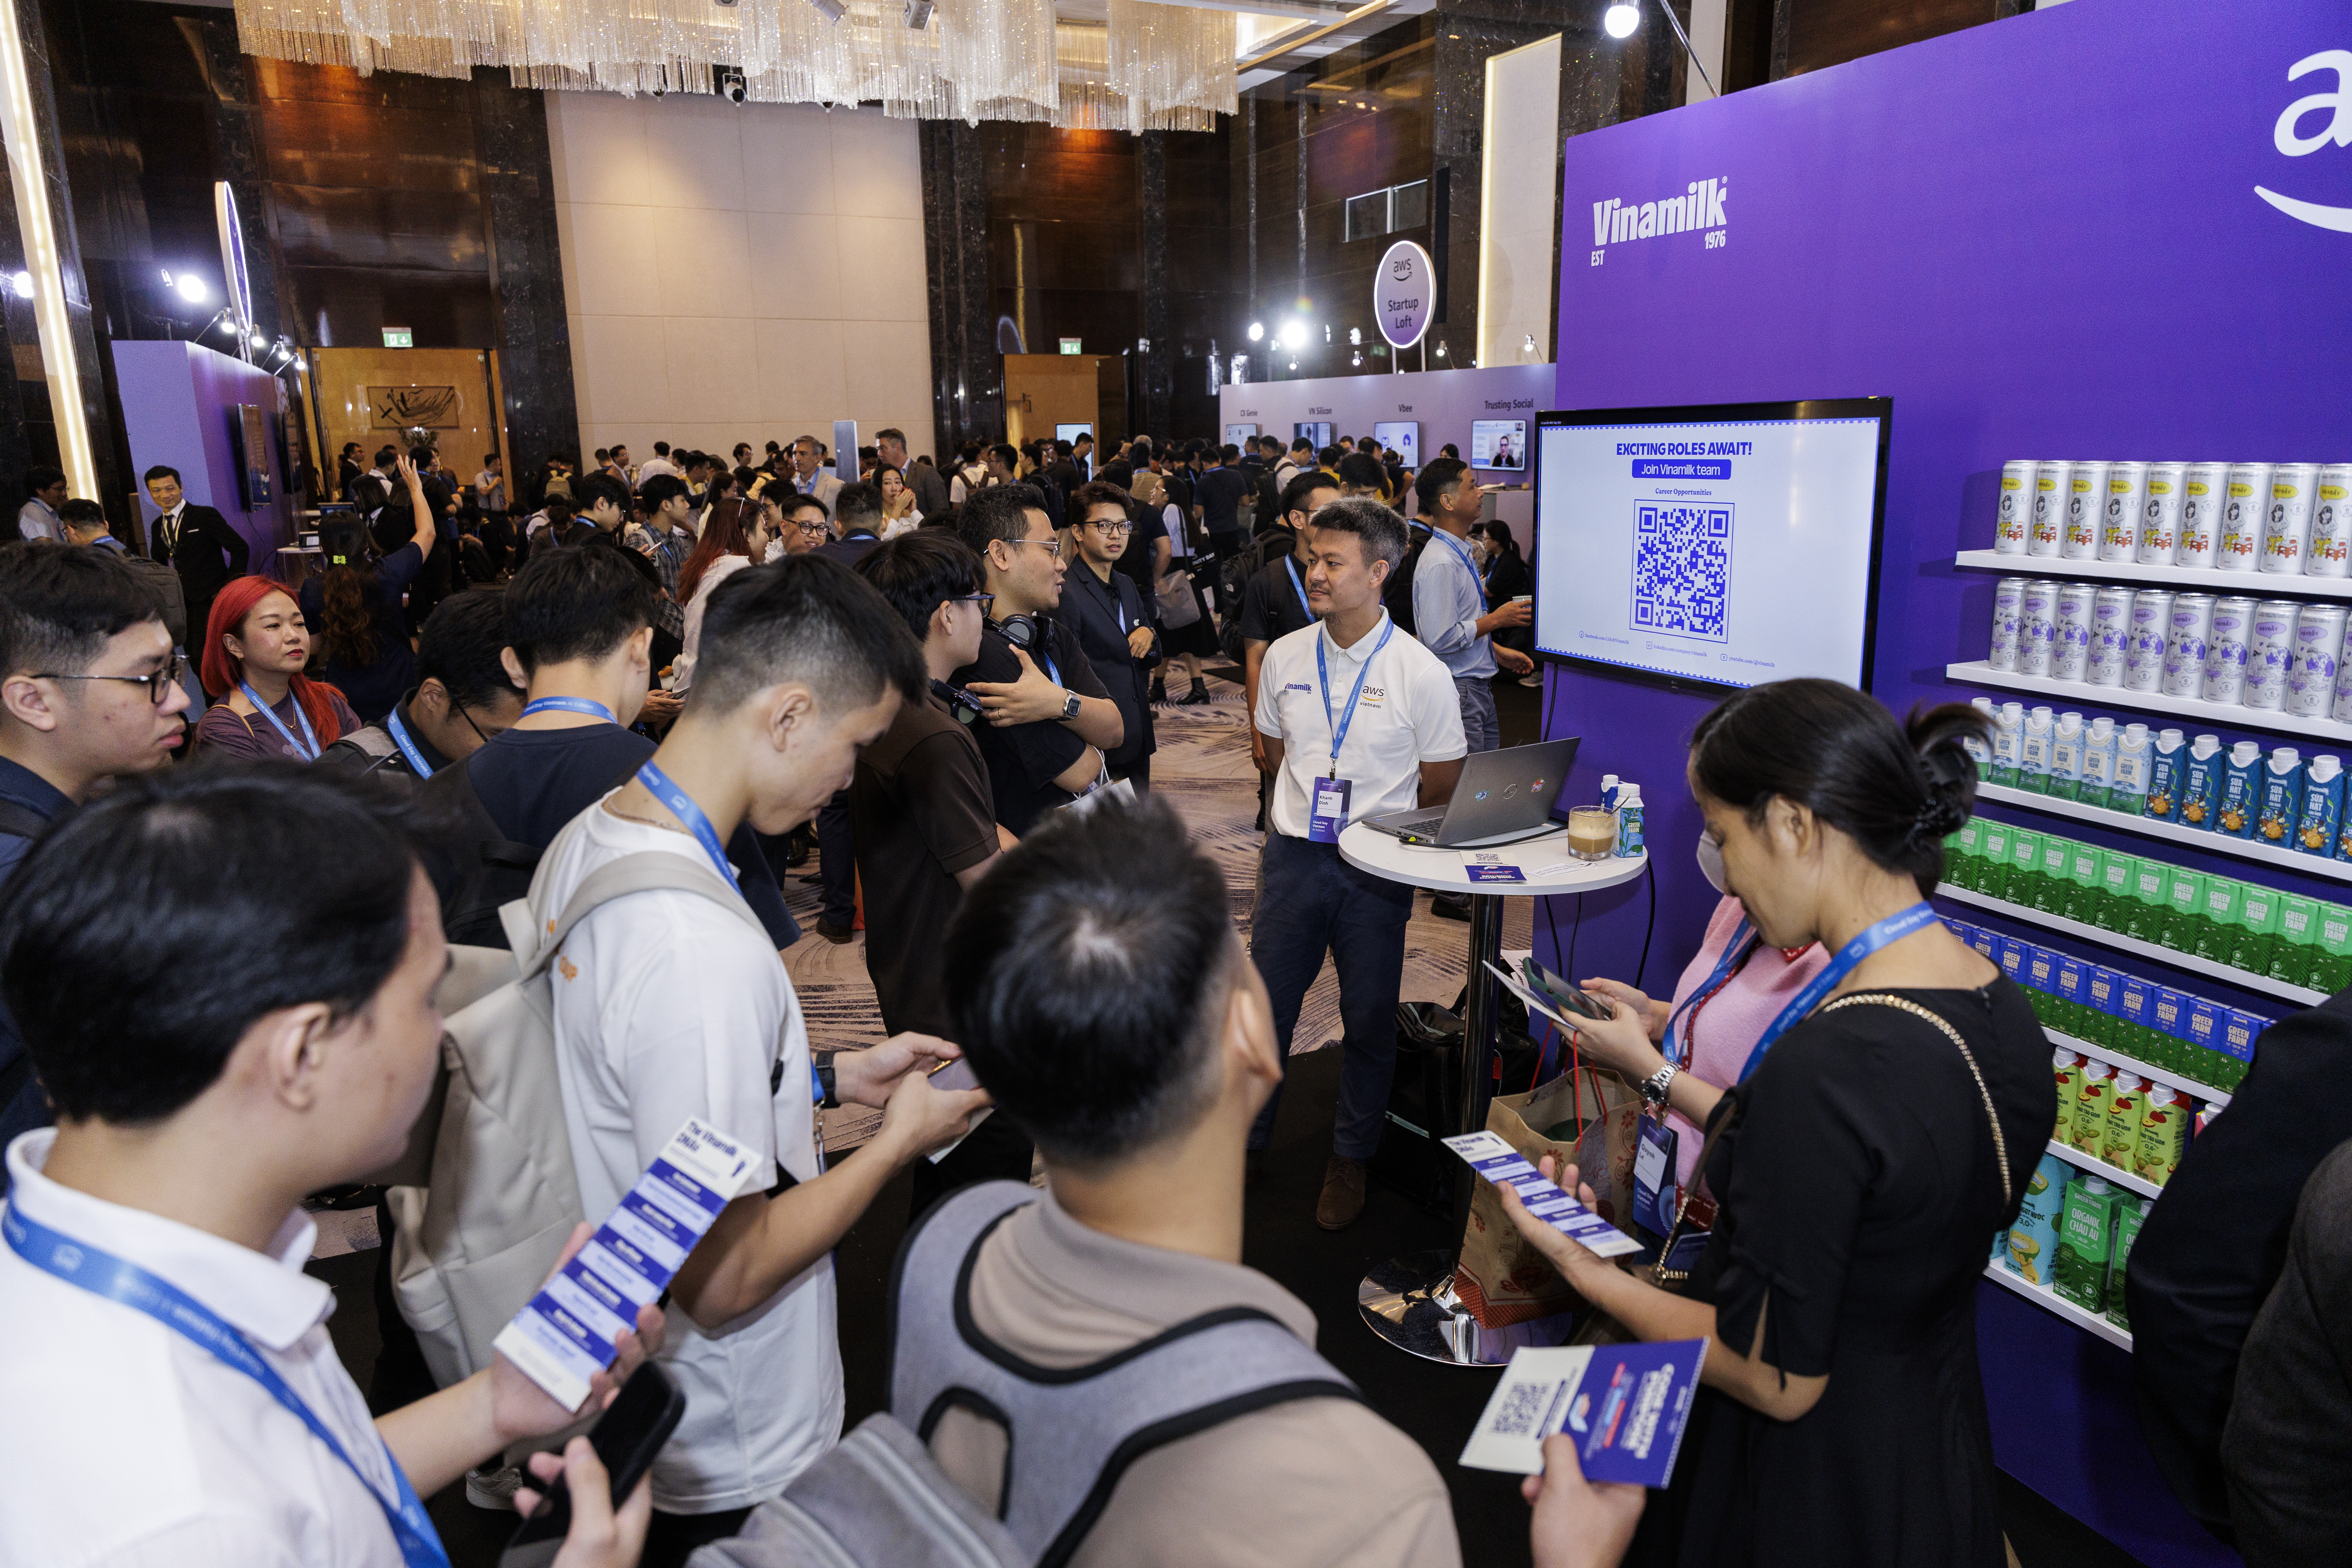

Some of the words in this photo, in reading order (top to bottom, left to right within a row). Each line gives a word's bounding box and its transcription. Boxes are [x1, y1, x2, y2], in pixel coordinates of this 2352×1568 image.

[1593, 178, 1727, 246] Vinamilk
[1704, 230, 1726, 249] 1976
[1591, 250, 1604, 266] EST
[1394, 259, 1411, 272] aws
[1388, 299, 1418, 312] Startup
[1395, 315, 1412, 328] Loft
[1398, 404, 1413, 412] Vbee
[1485, 400, 1511, 411] Trusting
[1513, 398, 1534, 408] Social
[1617, 443, 1665, 455] EXCITING
[1668, 443, 1705, 455] ROLES
[1708, 442, 1752, 455] AWAIT!
[1642, 464, 1658, 475] Join
[1660, 465, 1695, 475] Vinamilk
[1697, 465, 1720, 475] team
[1585, 633, 1629, 644] facebook.com/LifeAtVinamilk
[1653, 644, 1707, 657] linkedin.com/company/vinamilk
[1729, 656, 1775, 667] youtube.com/@vinamilk
[1363, 686, 1384, 696] aws
[264, 708, 275, 720] Vietnam
[400, 735, 411, 747] Cloud
[413, 755, 427, 772] Vietnam
[1987, 835, 2004, 846] GREEN
[1988, 842, 2002, 853] FARM
[2016, 842, 2033, 853] GREEN
[2016, 849, 2031, 860] FARM
[2046, 849, 2064, 860] GREEN
[2046, 857, 2062, 867] FARM
[2076, 857, 2094, 868] GREEN
[2076, 864, 2092, 875] FARM
[2107, 865, 2126, 877] GREEN
[2107, 873, 2123, 884] FARM
[2140, 874, 2160, 886] GREEN
[2140, 882, 2157, 893] FARM
[2174, 882, 2194, 894] GREEN
[2174, 890, 2192, 902] FARM
[2210, 891, 2231, 904] GREEN
[2209, 899, 2228, 911] FARM
[2247, 900, 2268, 913] GREEN
[2246, 909, 2266, 921] FARM
[2285, 910, 2308, 923] GREEN
[2285, 919, 2305, 931] FARM
[2325, 920, 2348, 934] GREEN
[2325, 929, 2345, 942] FARM
[2004, 951, 2020, 963] GREEN
[2003, 958, 2018, 969] FARM
[2033, 960, 2050, 972] GREEN
[2032, 968, 2047, 979] FARM
[2061, 970, 2078, 982] GREEN
[2060, 978, 2076, 989] FARM
[2092, 980, 2110, 993] GREEN
[2092, 988, 2108, 1000] FARM
[2124, 991, 2143, 1004] GREEN
[2123, 999, 2141, 1011] FARM
[2157, 1002, 2178, 1015] GREEN
[2157, 1011, 2176, 1023] FARM
[2192, 1013, 2213, 1027] GREEN
[2192, 1022, 2211, 1034] FARM
[2228, 1025, 2249, 1039] GREEN
[2227, 1034, 2247, 1047] FARM
[2074, 1193, 2089, 1203] GREEN
[2072, 1208, 2100, 1229] ORGANIC
